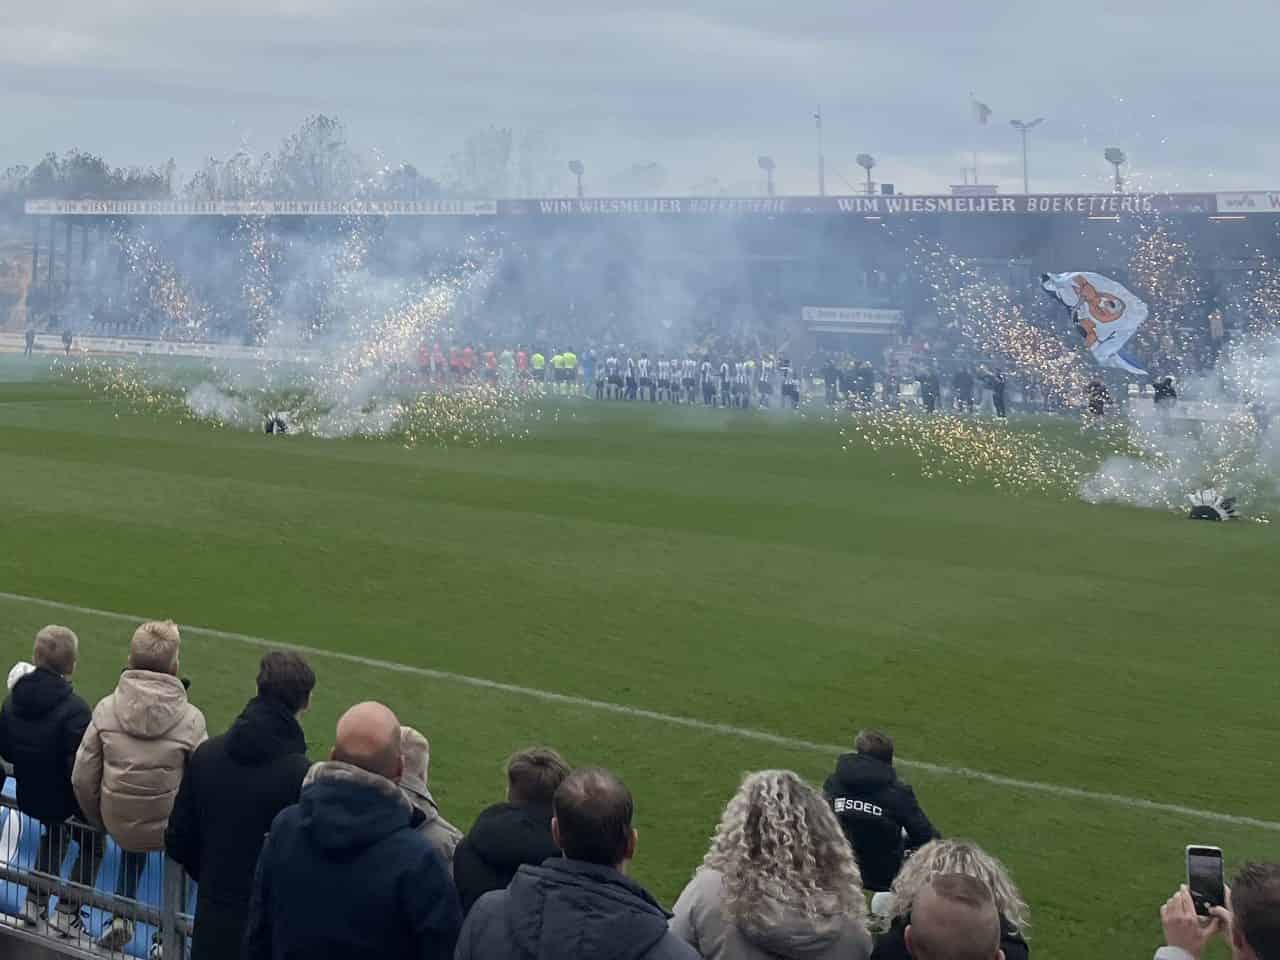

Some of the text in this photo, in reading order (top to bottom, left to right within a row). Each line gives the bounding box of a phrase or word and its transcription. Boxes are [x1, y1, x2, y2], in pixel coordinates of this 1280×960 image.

[540, 200, 571, 213] WIM
[838, 198, 878, 212] WIM
[886, 198, 1015, 212] WIESMEIJER
